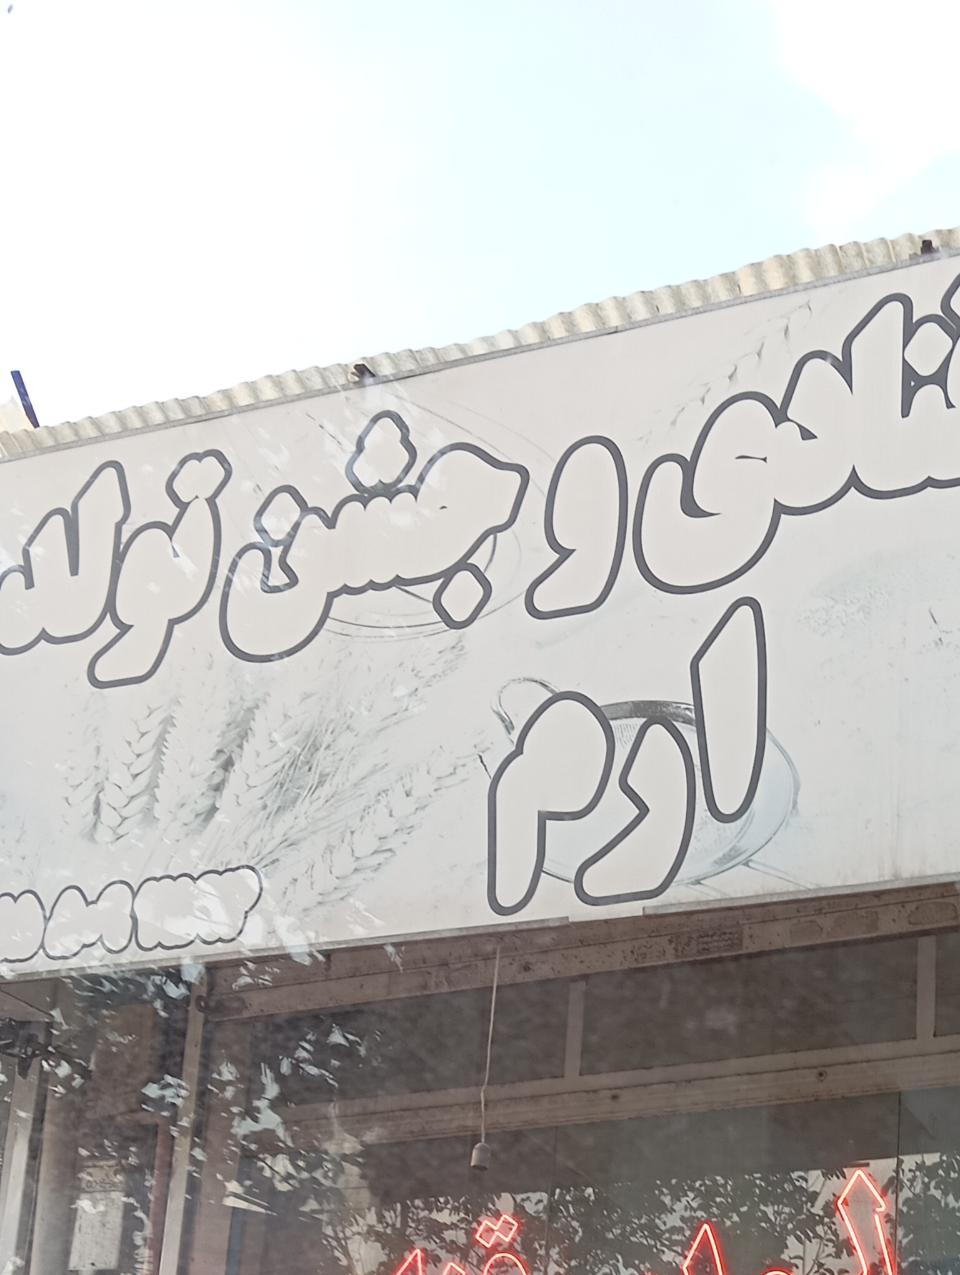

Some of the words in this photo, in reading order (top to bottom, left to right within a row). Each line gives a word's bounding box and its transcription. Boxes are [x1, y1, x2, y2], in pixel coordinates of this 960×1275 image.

[219, 410, 530, 662] جشن
[525, 435, 628, 619] و
[488, 596, 768, 916] ارم
